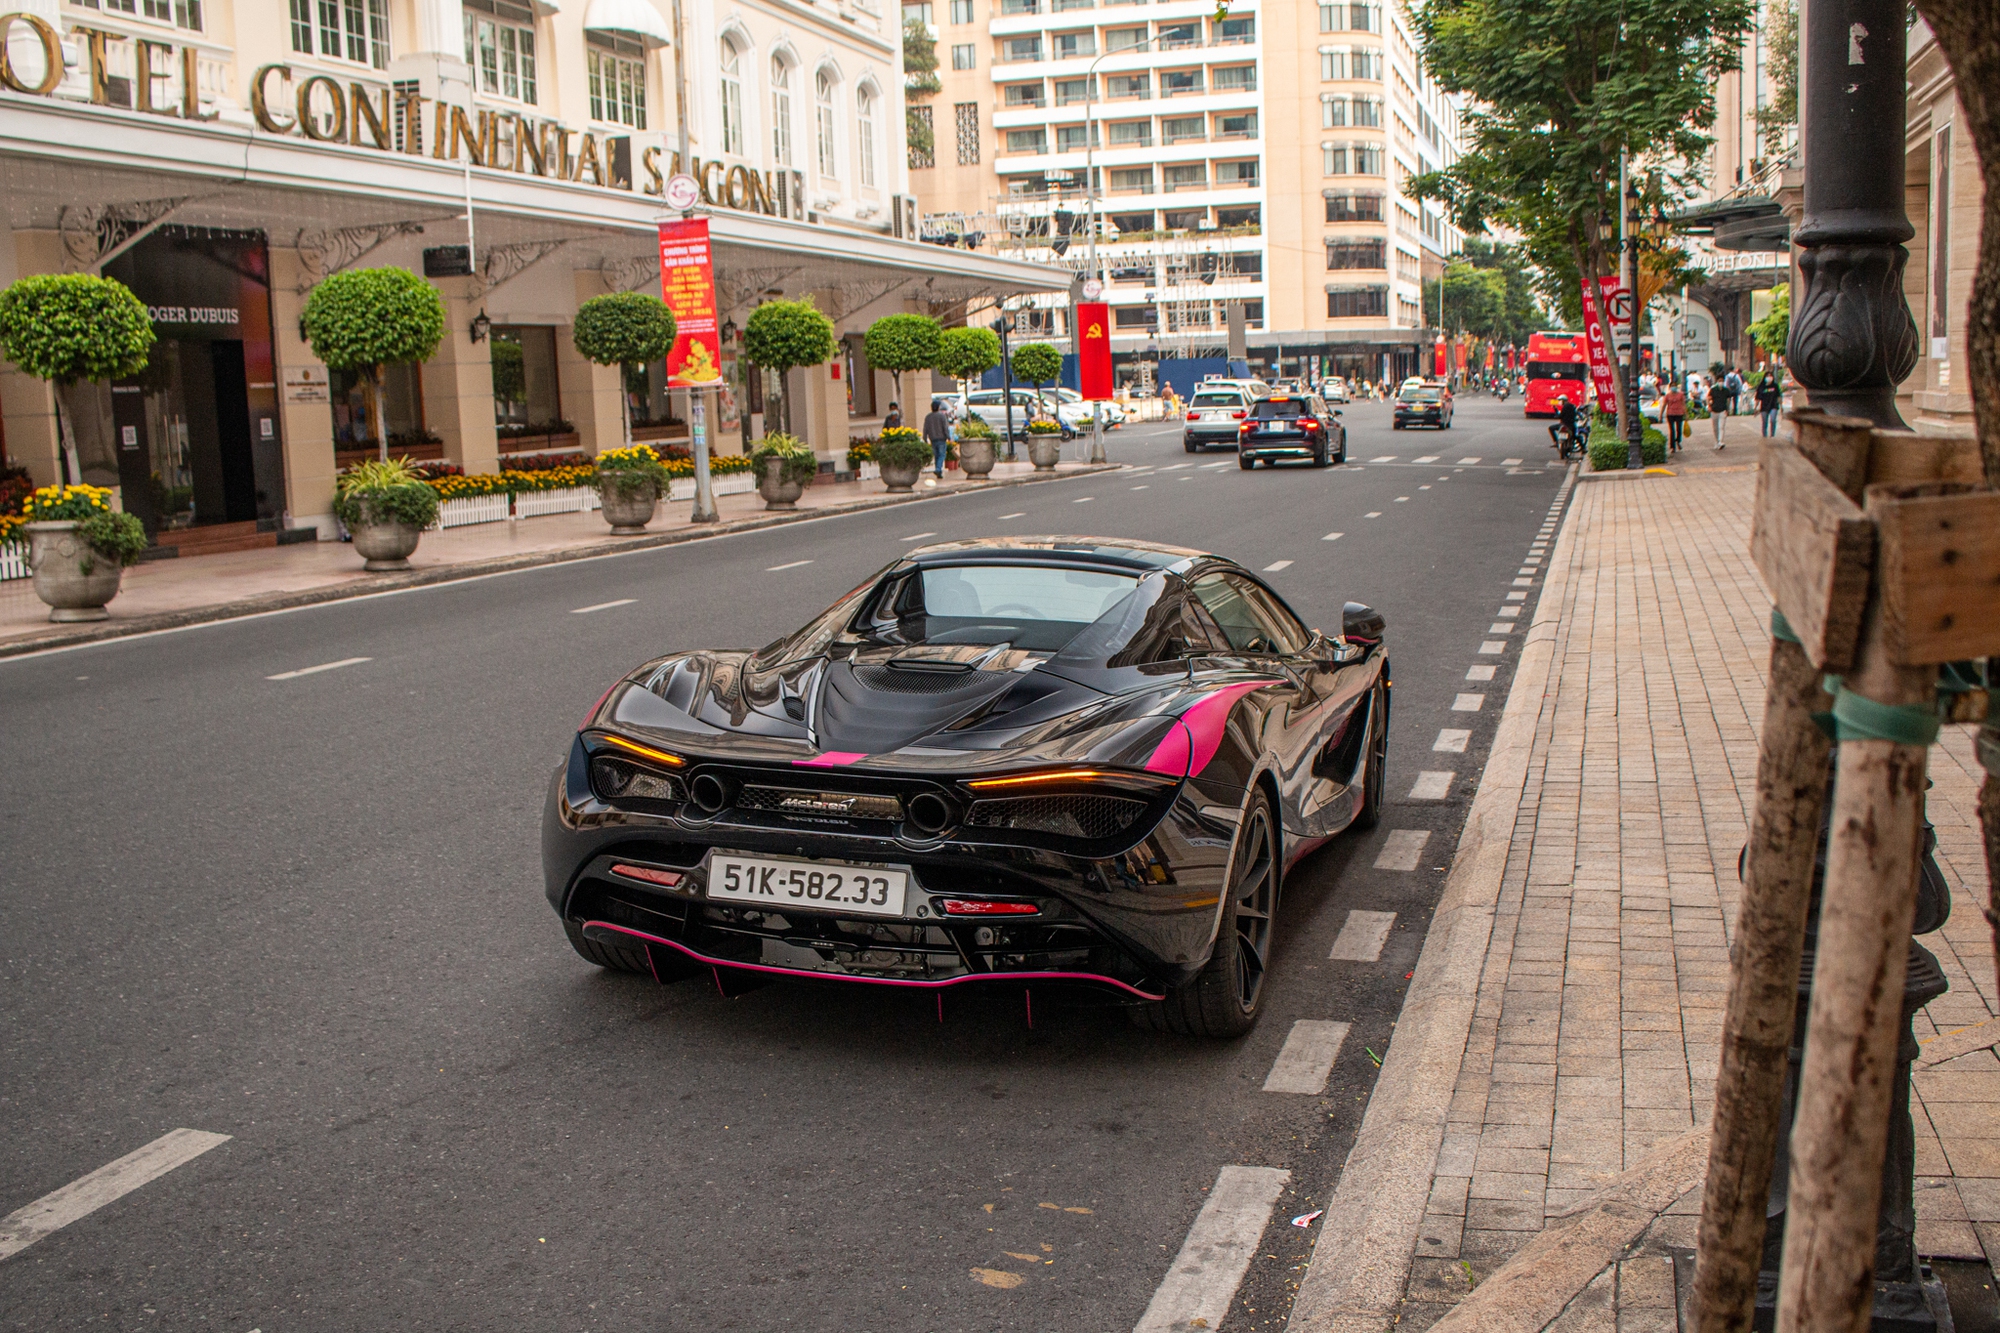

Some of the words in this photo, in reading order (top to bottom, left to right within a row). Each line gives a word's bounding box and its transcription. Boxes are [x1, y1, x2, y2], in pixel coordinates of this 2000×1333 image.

[251, 64, 628, 189] CONTINENTAL
[1694, 252, 1766, 274] VUITTON
[148, 306, 188, 323] OGER
[190, 307, 239, 324] DUBUIS
[780, 798, 847, 811] McLaren
[724, 863, 890, 906] 51K-582.33
